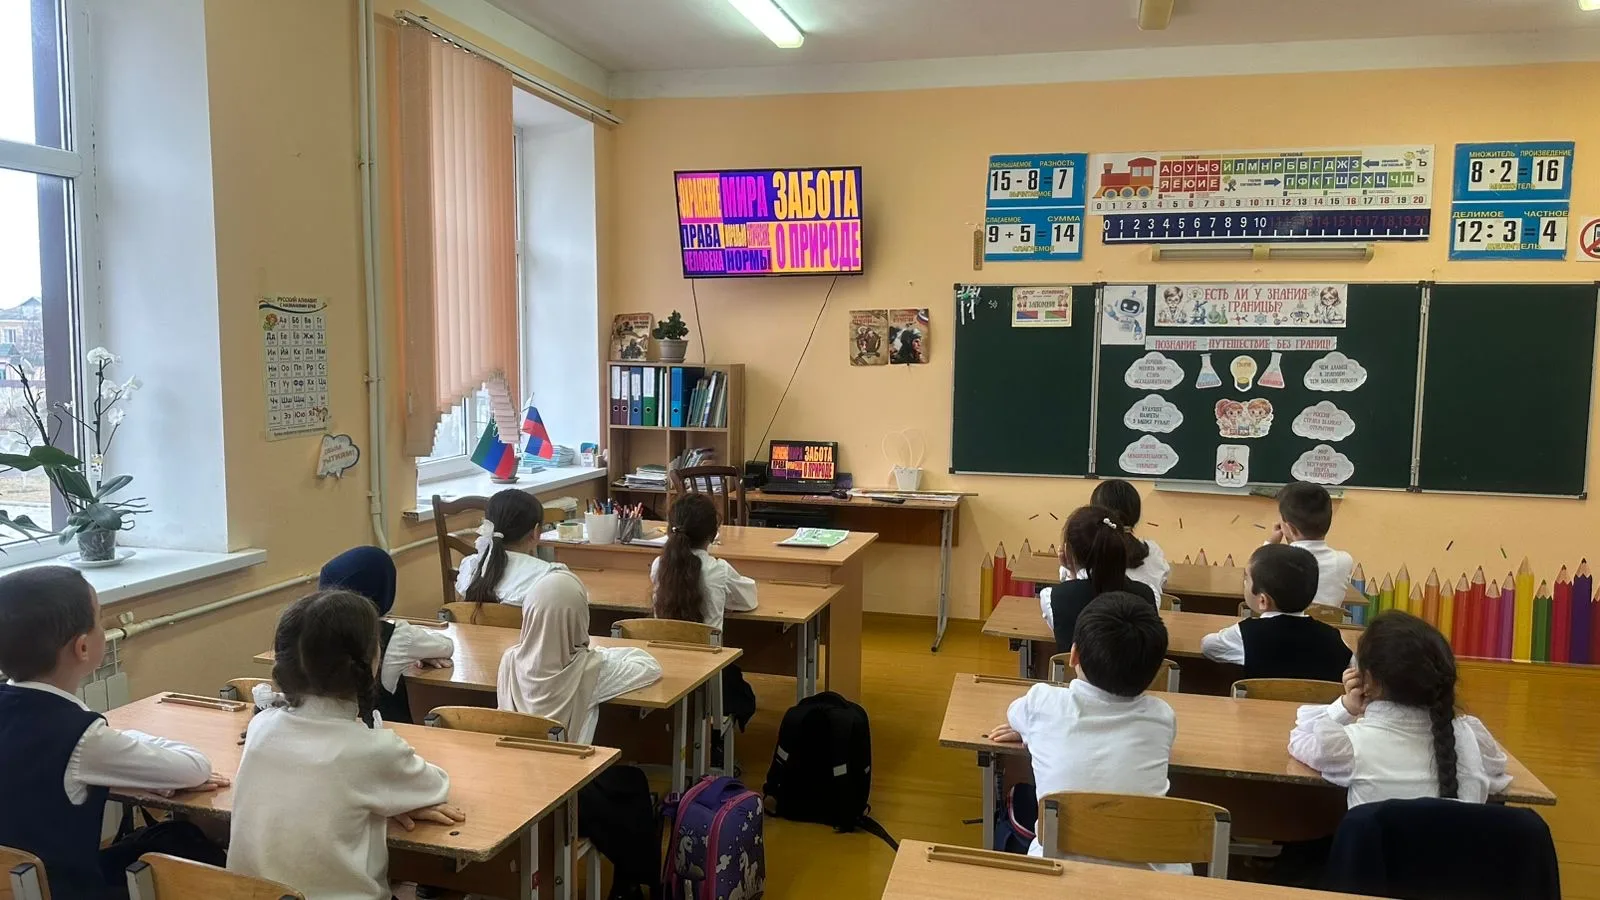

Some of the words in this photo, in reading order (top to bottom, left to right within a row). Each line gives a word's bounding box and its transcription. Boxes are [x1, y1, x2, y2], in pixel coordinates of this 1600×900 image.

[1161, 165, 1170, 173] А
[1173, 165, 1182, 173] О
[1198, 164, 1208, 172] Ы
[1224, 162, 1231, 170] Й
[1236, 163, 1244, 171] Л
[1248, 163, 1257, 171] М
[1274, 162, 1281, 170] Р
[1287, 161, 1295, 170] Б
[1300, 161, 1308, 170] В
[1313, 161, 1320, 169] Г
[1325, 161, 1334, 170] Д
[1337, 160, 1348, 168] Ж
[1352, 160, 1359, 168] З
[1417, 159, 1427, 167] Ъ
[1471, 161, 1483, 183] 8
[1500, 160, 1512, 183] 2
[1536, 159, 1559, 182] 16
[992, 171, 1011, 191] 15
[1028, 170, 1038, 190] 8
[1058, 169, 1067, 189] 7
[1184, 180, 1194, 188] Ю
[1211, 179, 1218, 187] Е
[1298, 177, 1307, 185] Ф
[1312, 177, 1319, 185] К
[1336, 176, 1347, 184] Ш
[1351, 176, 1358, 184] С
[1364, 176, 1371, 184] Х
[1376, 176, 1385, 185] Ц
[1391, 175, 1398, 183] Ч
[1402, 175, 1413, 184] Щ
[1417, 175, 1425, 183] Ь
[722, 175, 768, 217] МИРА
[773, 170, 858, 220] ЗАБОТА
[989, 226, 999, 242] 9
[1020, 225, 1030, 242] 5
[1054, 225, 1075, 242] 14
[1104, 220, 1110, 231] 0
[1120, 220, 1124, 229] 1
[1134, 219, 1140, 230] 2
[1148, 219, 1154, 229] 3
[1163, 219, 1170, 229] 4
[1178, 218, 1185, 228] 5
[1194, 218, 1200, 228] 6
[1210, 218, 1216, 228] 7
[1225, 217, 1232, 228] 8
[1240, 217, 1247, 227] 9
[1254, 217, 1267, 228] 10
[1457, 221, 1482, 242] 12
[1503, 220, 1516, 242] 3
[1543, 220, 1556, 242] 4
[681, 224, 721, 248] ПРАВА
[775, 223, 786, 269] О
[788, 221, 860, 271] ПРИРОДЕ
[684, 250, 725, 272] ЧЕЛОВЕКА
[726, 249, 771, 271] НОРМЫ
[1205, 288, 1229, 300] ЕСТЬ
[1234, 288, 1248, 300] ЛИ
[1255, 288, 1262, 300] У
[1268, 288, 1308, 300] ЗНАНИЯ
[1228, 301, 1283, 314] ГРАНИЦЫ?
[1155, 340, 1197, 349] ПОЗНАНИЕ
[1208, 339, 1270, 349] ПУТЕШЕСТВИЕ
[1277, 339, 1291, 349] БЕЗ
[805, 446, 832, 462] ЗАБОТА
[808, 462, 832, 479] ПРИРОДЕ
